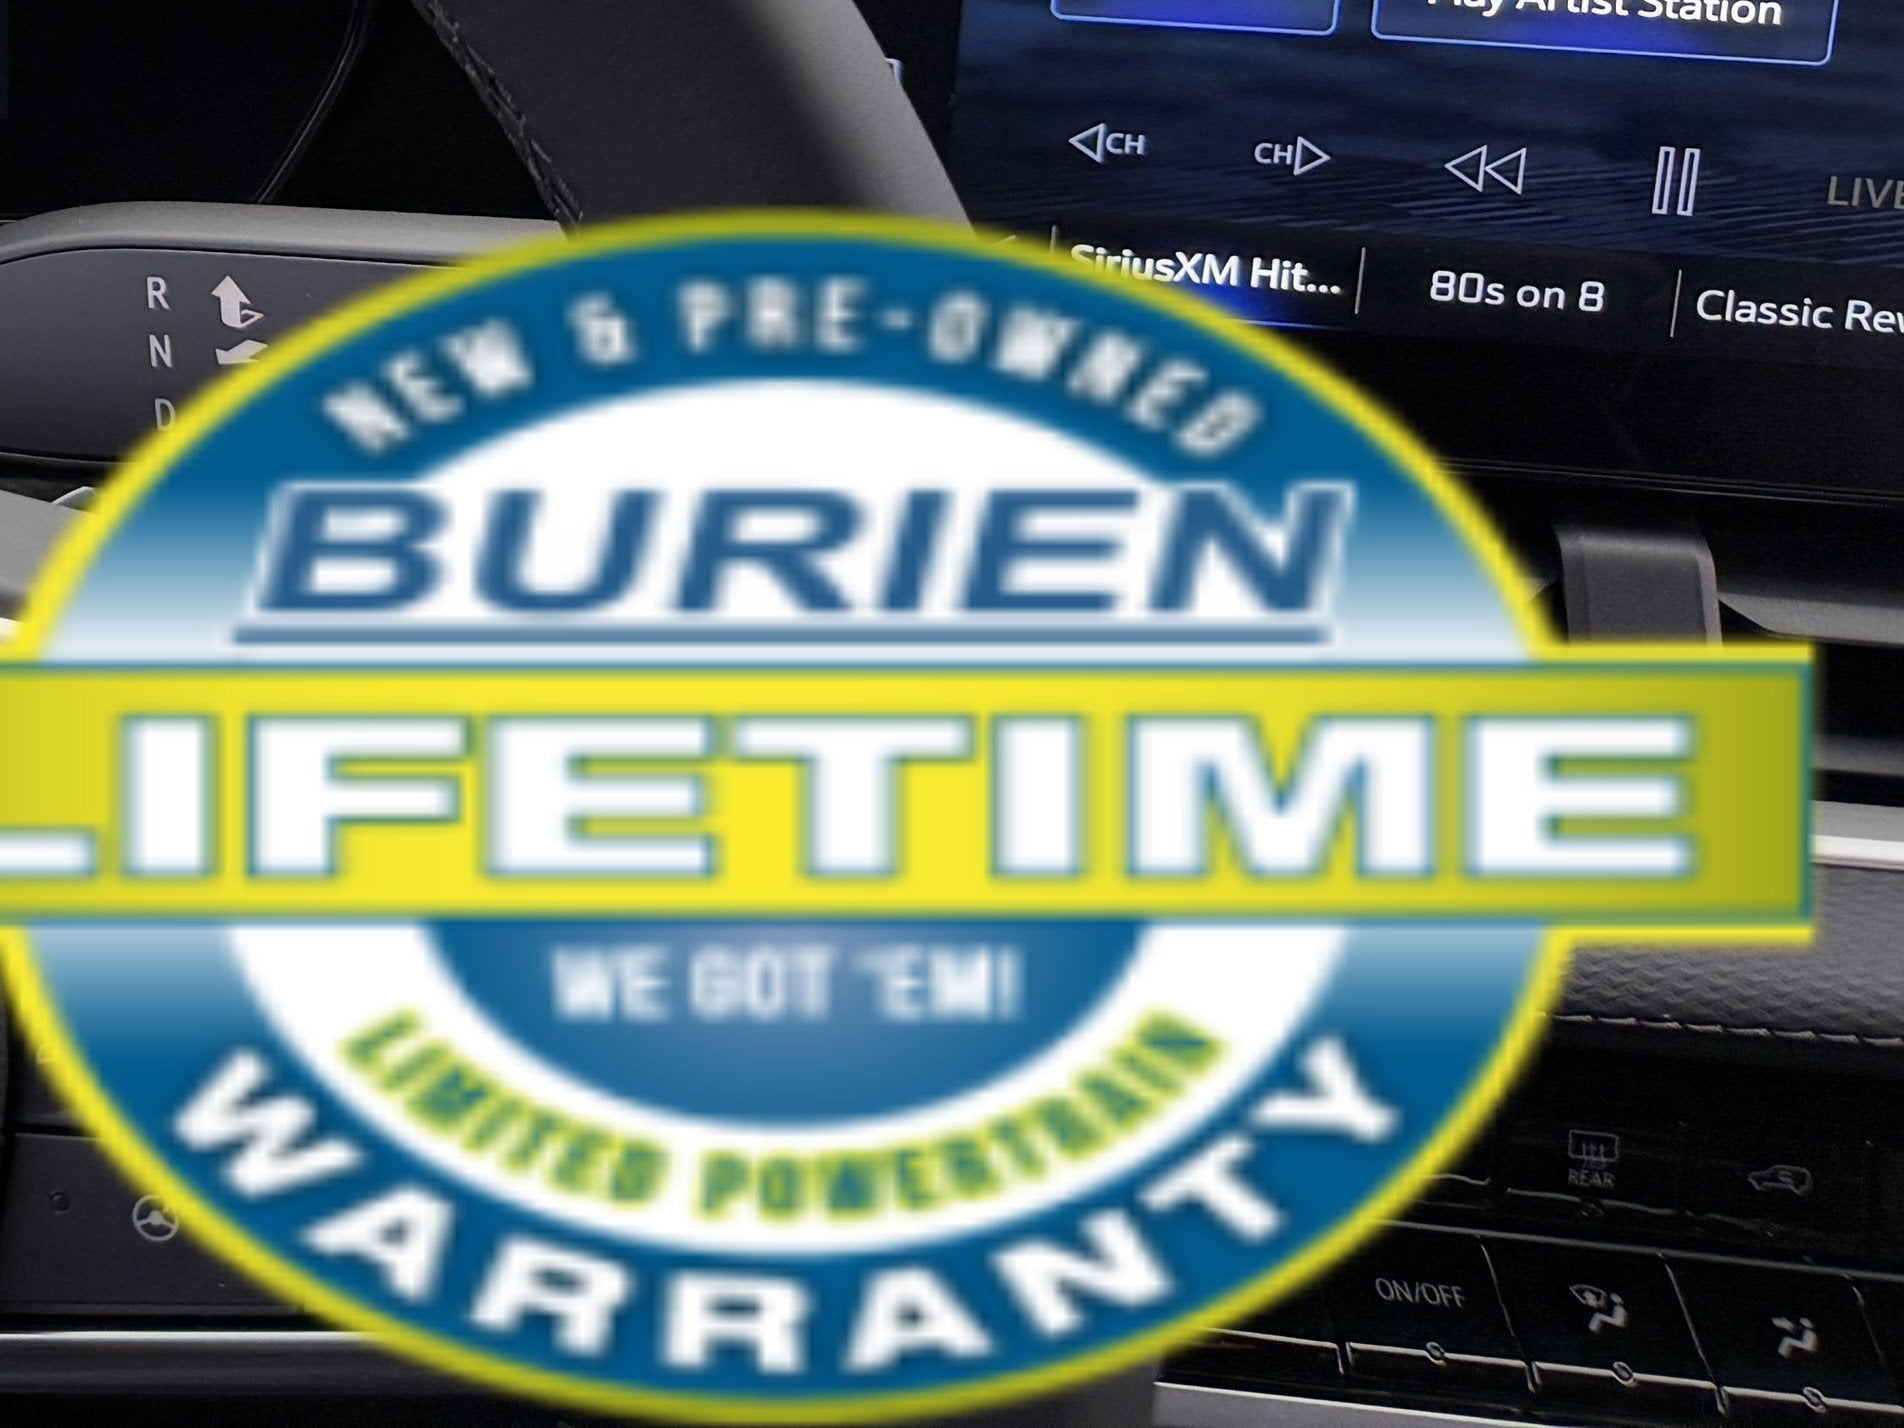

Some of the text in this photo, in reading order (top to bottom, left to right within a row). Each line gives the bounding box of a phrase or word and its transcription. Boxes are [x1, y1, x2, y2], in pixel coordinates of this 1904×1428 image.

[1105, 132, 1148, 155] CH
[1253, 142, 1292, 165] CH
[146, 275, 173, 310] R
[1429, 270, 1605, 313] 80s on 8
[1696, 288, 1834, 330] Classic
[148, 333, 174, 369] N
[1567, 1167, 1616, 1189] REAR
[1374, 1276, 1465, 1309] ON/OFF
